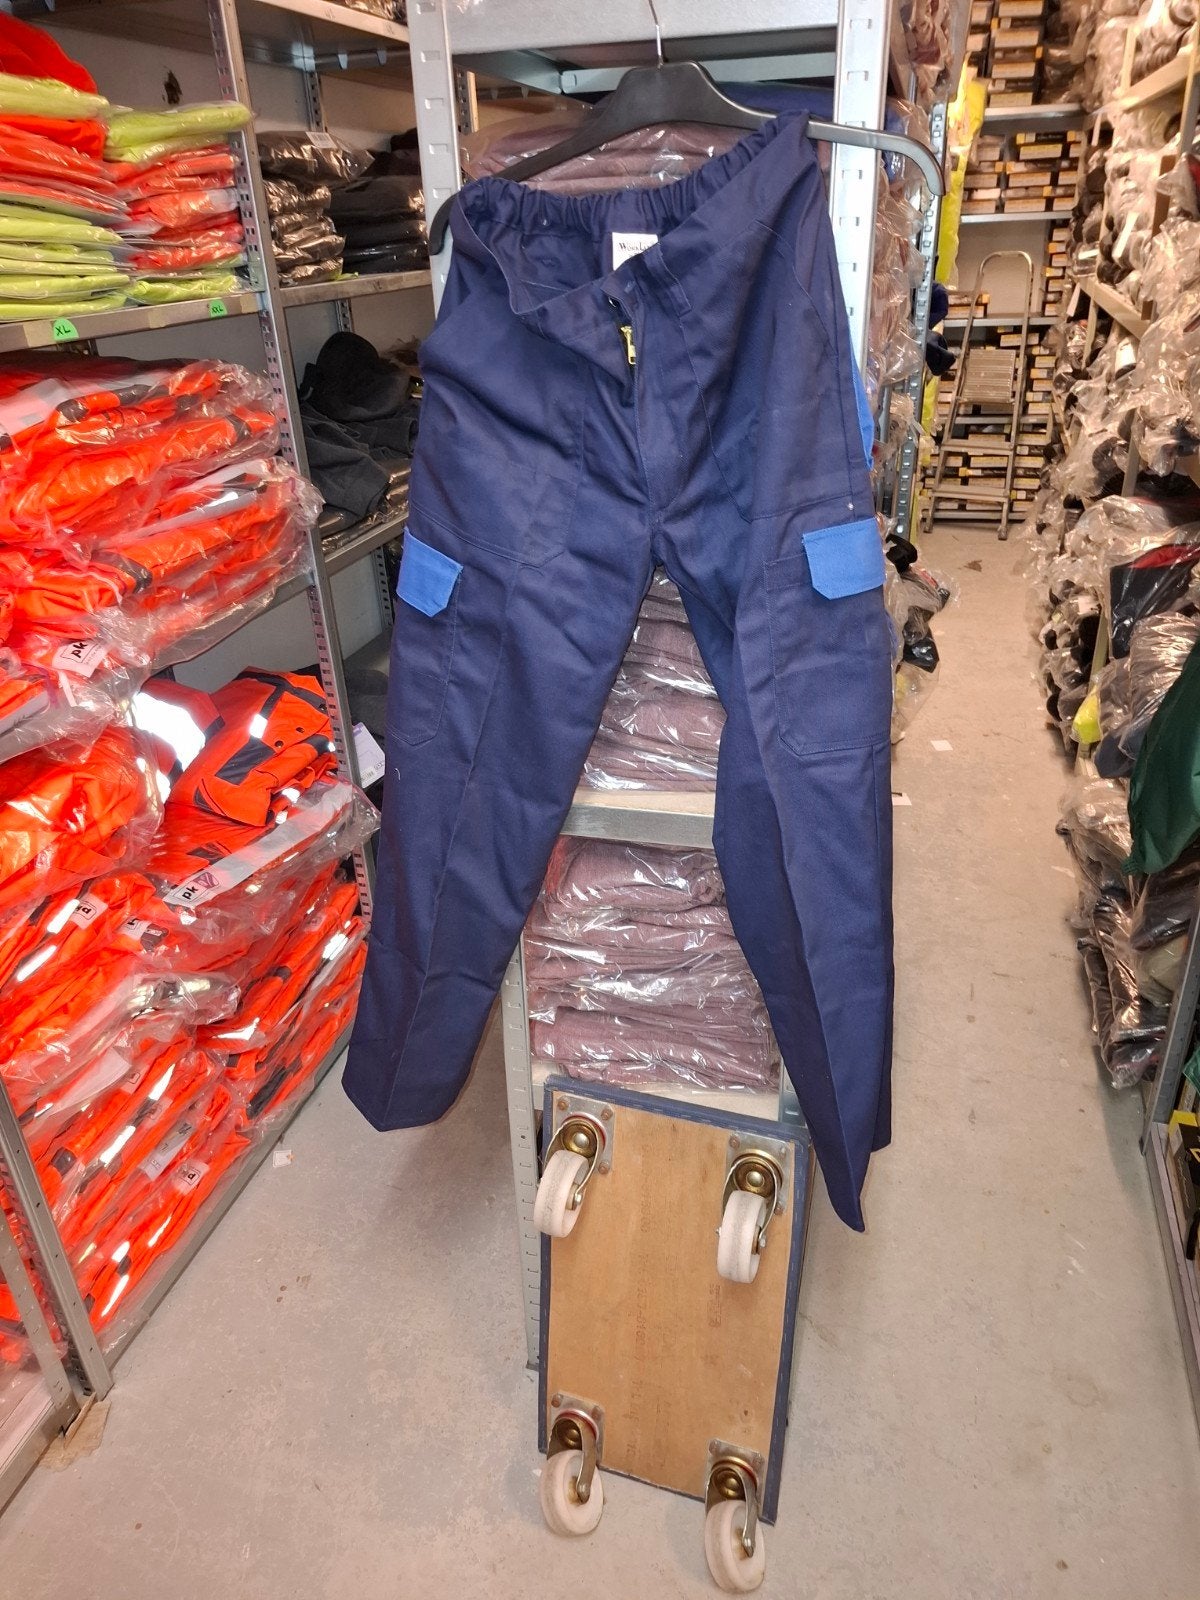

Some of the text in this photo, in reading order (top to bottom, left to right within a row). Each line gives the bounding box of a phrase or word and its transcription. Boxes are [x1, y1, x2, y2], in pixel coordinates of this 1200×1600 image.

[55, 324, 71, 337] XL
[70, 642, 88, 659] pk
[182, 885, 199, 900] pk
